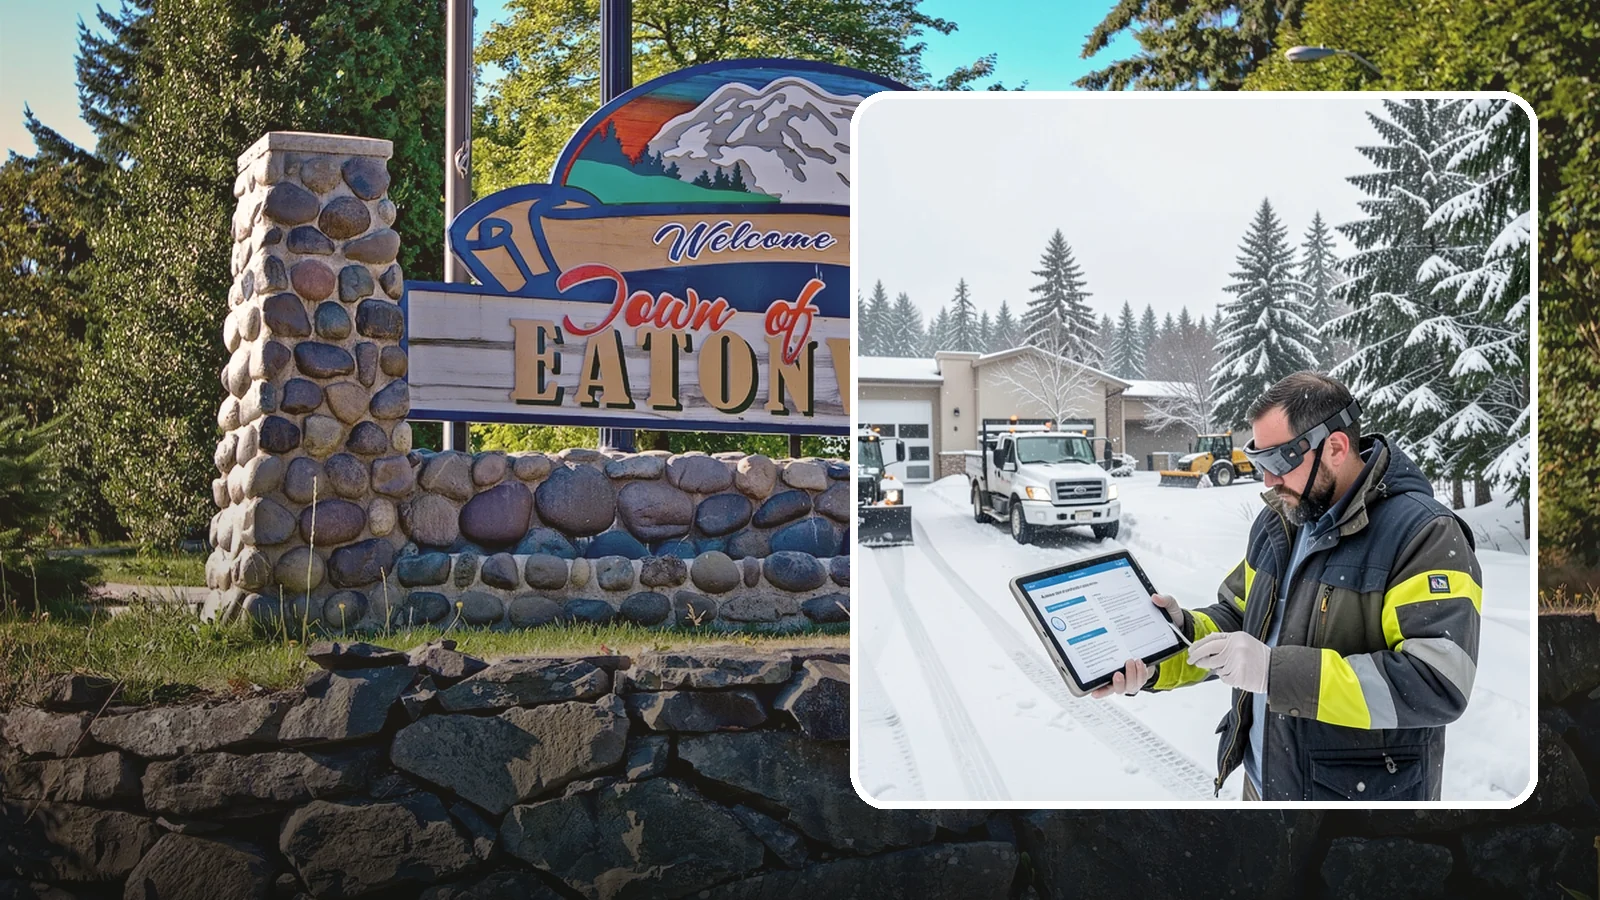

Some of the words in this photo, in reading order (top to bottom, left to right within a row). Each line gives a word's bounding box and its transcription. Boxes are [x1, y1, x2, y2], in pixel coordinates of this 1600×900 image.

[654, 222, 836, 262] Welcome
[557, 263, 737, 336] Town
[765, 278, 826, 364] of
